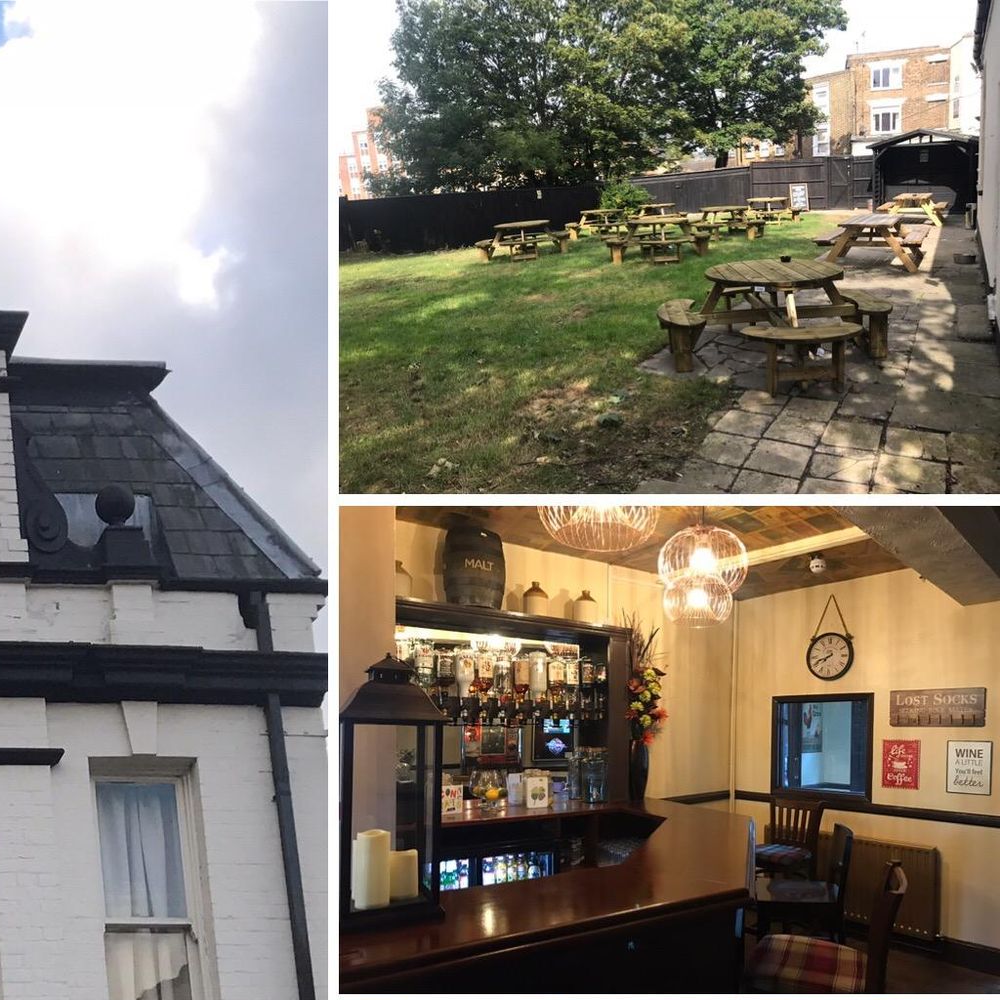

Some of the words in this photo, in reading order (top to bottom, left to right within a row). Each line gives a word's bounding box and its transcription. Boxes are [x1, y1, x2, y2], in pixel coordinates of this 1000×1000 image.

[464, 558, 494, 572] MALT
[896, 694, 929, 706] LOST
[933, 692, 978, 706] SOCKS
[955, 748, 984, 759] WINE
[961, 759, 983, 767] LITTLE
